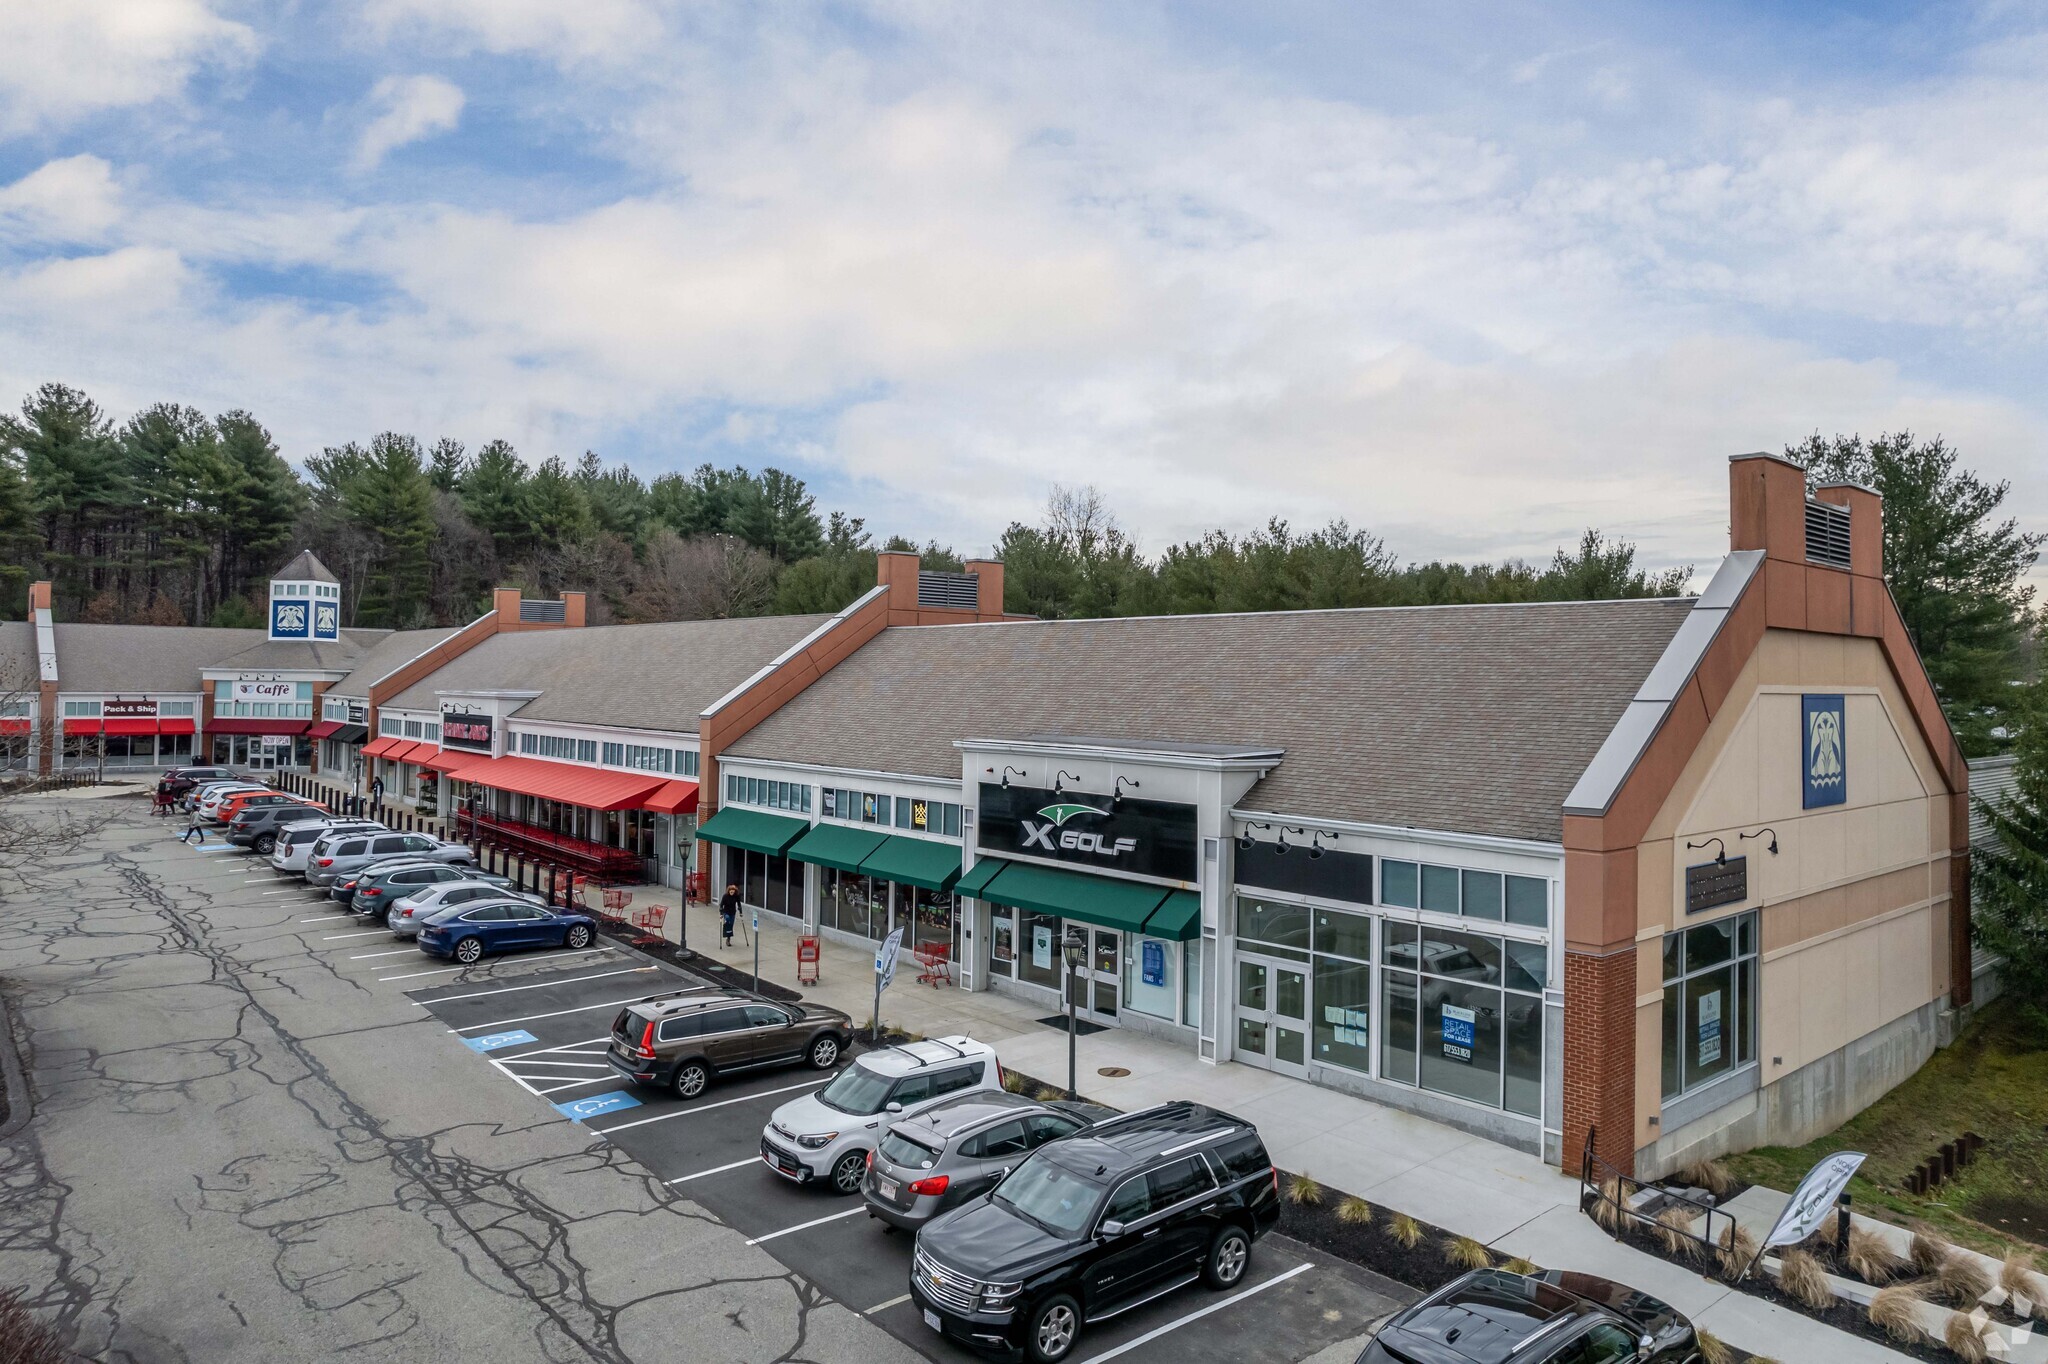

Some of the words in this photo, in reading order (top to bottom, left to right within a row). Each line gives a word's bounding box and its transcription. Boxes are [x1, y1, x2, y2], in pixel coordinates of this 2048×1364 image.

[256, 684, 290, 696] Caffè
[104, 705, 126, 713] Pack
[127, 705, 135, 713] &
[136, 705, 157, 714] Ship
[264, 736, 275, 745] NOW
[276, 736, 289, 745] OPEN
[1021, 820, 1056, 850] X
[1060, 830, 1136, 856] GOLF
[1444, 1018, 1470, 1032] RETAIL
[1444, 1026, 1471, 1039] SPACE
[1455, 1035, 1471, 1044] LEASE
